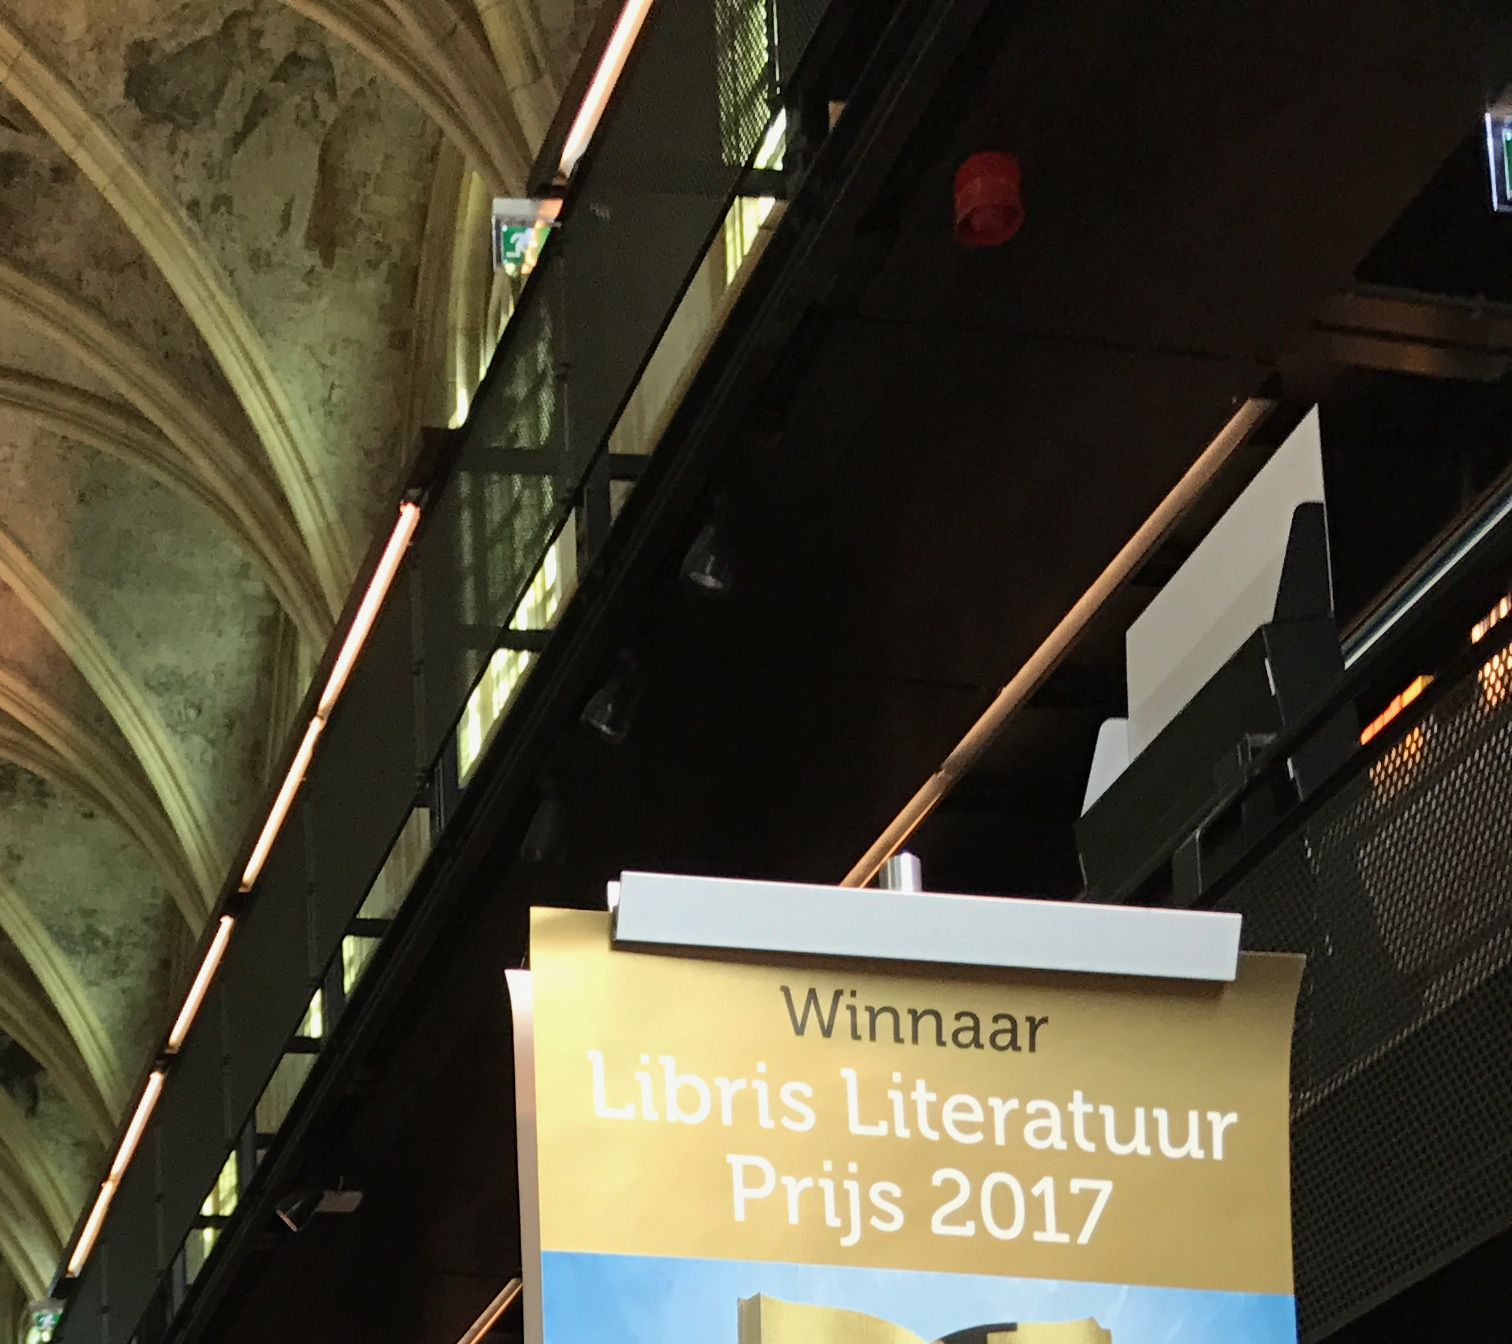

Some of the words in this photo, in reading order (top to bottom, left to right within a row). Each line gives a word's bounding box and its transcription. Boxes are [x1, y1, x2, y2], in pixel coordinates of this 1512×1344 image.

[779, 983, 1050, 1054] Winnaar
[586, 1049, 816, 1133] Libris
[839, 1066, 1239, 1162] Literatuur
[724, 1153, 905, 1247] Prijs
[930, 1168, 1114, 1246] 2017
